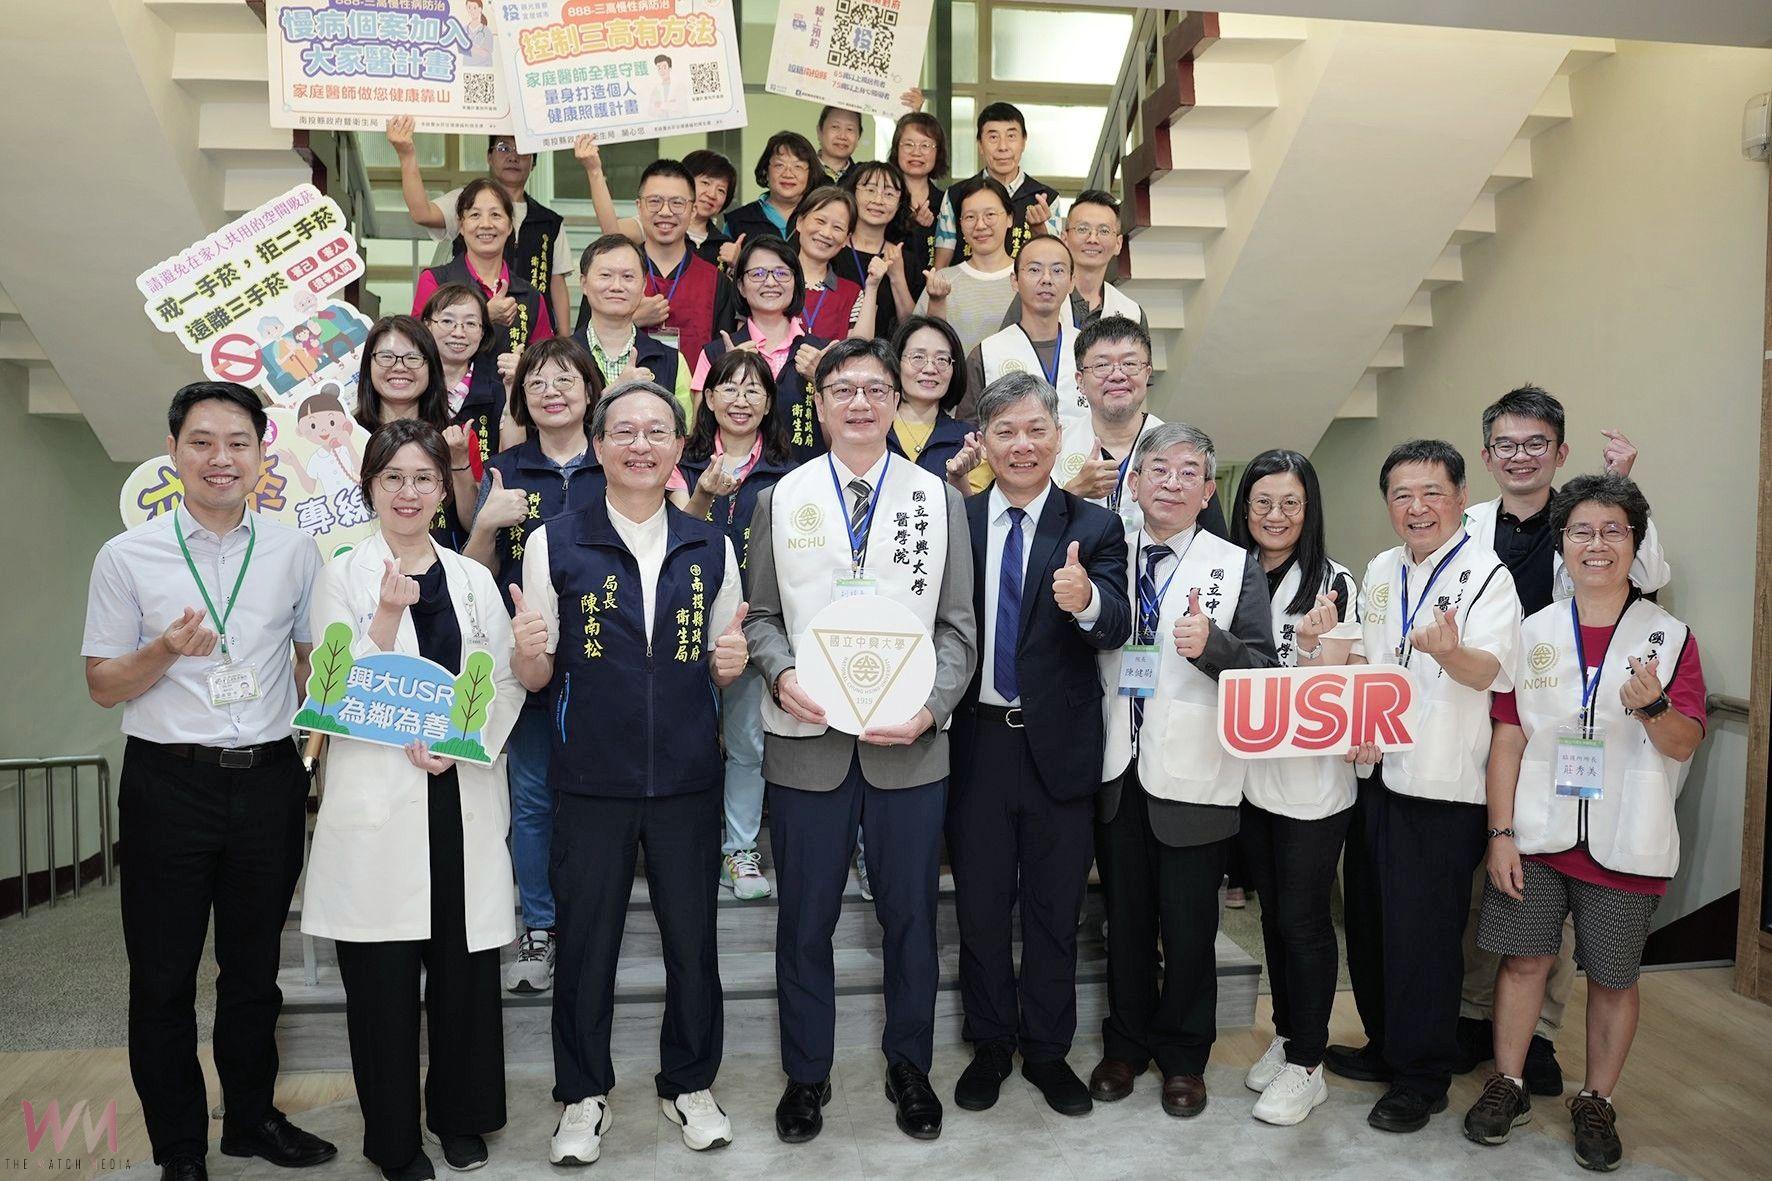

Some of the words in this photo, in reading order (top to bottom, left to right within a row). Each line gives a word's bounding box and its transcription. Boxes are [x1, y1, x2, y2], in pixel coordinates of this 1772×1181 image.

[281, 9, 471, 49] 慢病個案加入
[521, 15, 717, 62] 控制三高有方法
[303, 44, 454, 81] 大家醫計畫
[525, 61, 649, 88] 家庭醫師全程守護
[293, 84, 450, 103] 家庭醫師做您健康靠山
[545, 81, 637, 106] 量身打造個人
[547, 99, 640, 124] 健康照護計畫
[185, 272, 289, 344] 遠離三手菸
[527, 492, 541, 520] 科長
[787, 535, 826, 550] NCHU
[893, 511, 911, 565] 醫學院
[911, 490, 930, 596] 國立中興大學
[602, 574, 619, 609] 局長
[580, 592, 604, 659] 陳南松
[674, 608, 690, 663] 衛生局
[690, 577, 705, 662] 南投縣政府
[829, 634, 906, 651] 國立中興大學
[856, 697, 873, 705] 1919
[1523, 677, 1558, 691] NCHU
[337, 695, 451, 740] 為鄰為善
[1223, 672, 1414, 753] USR
